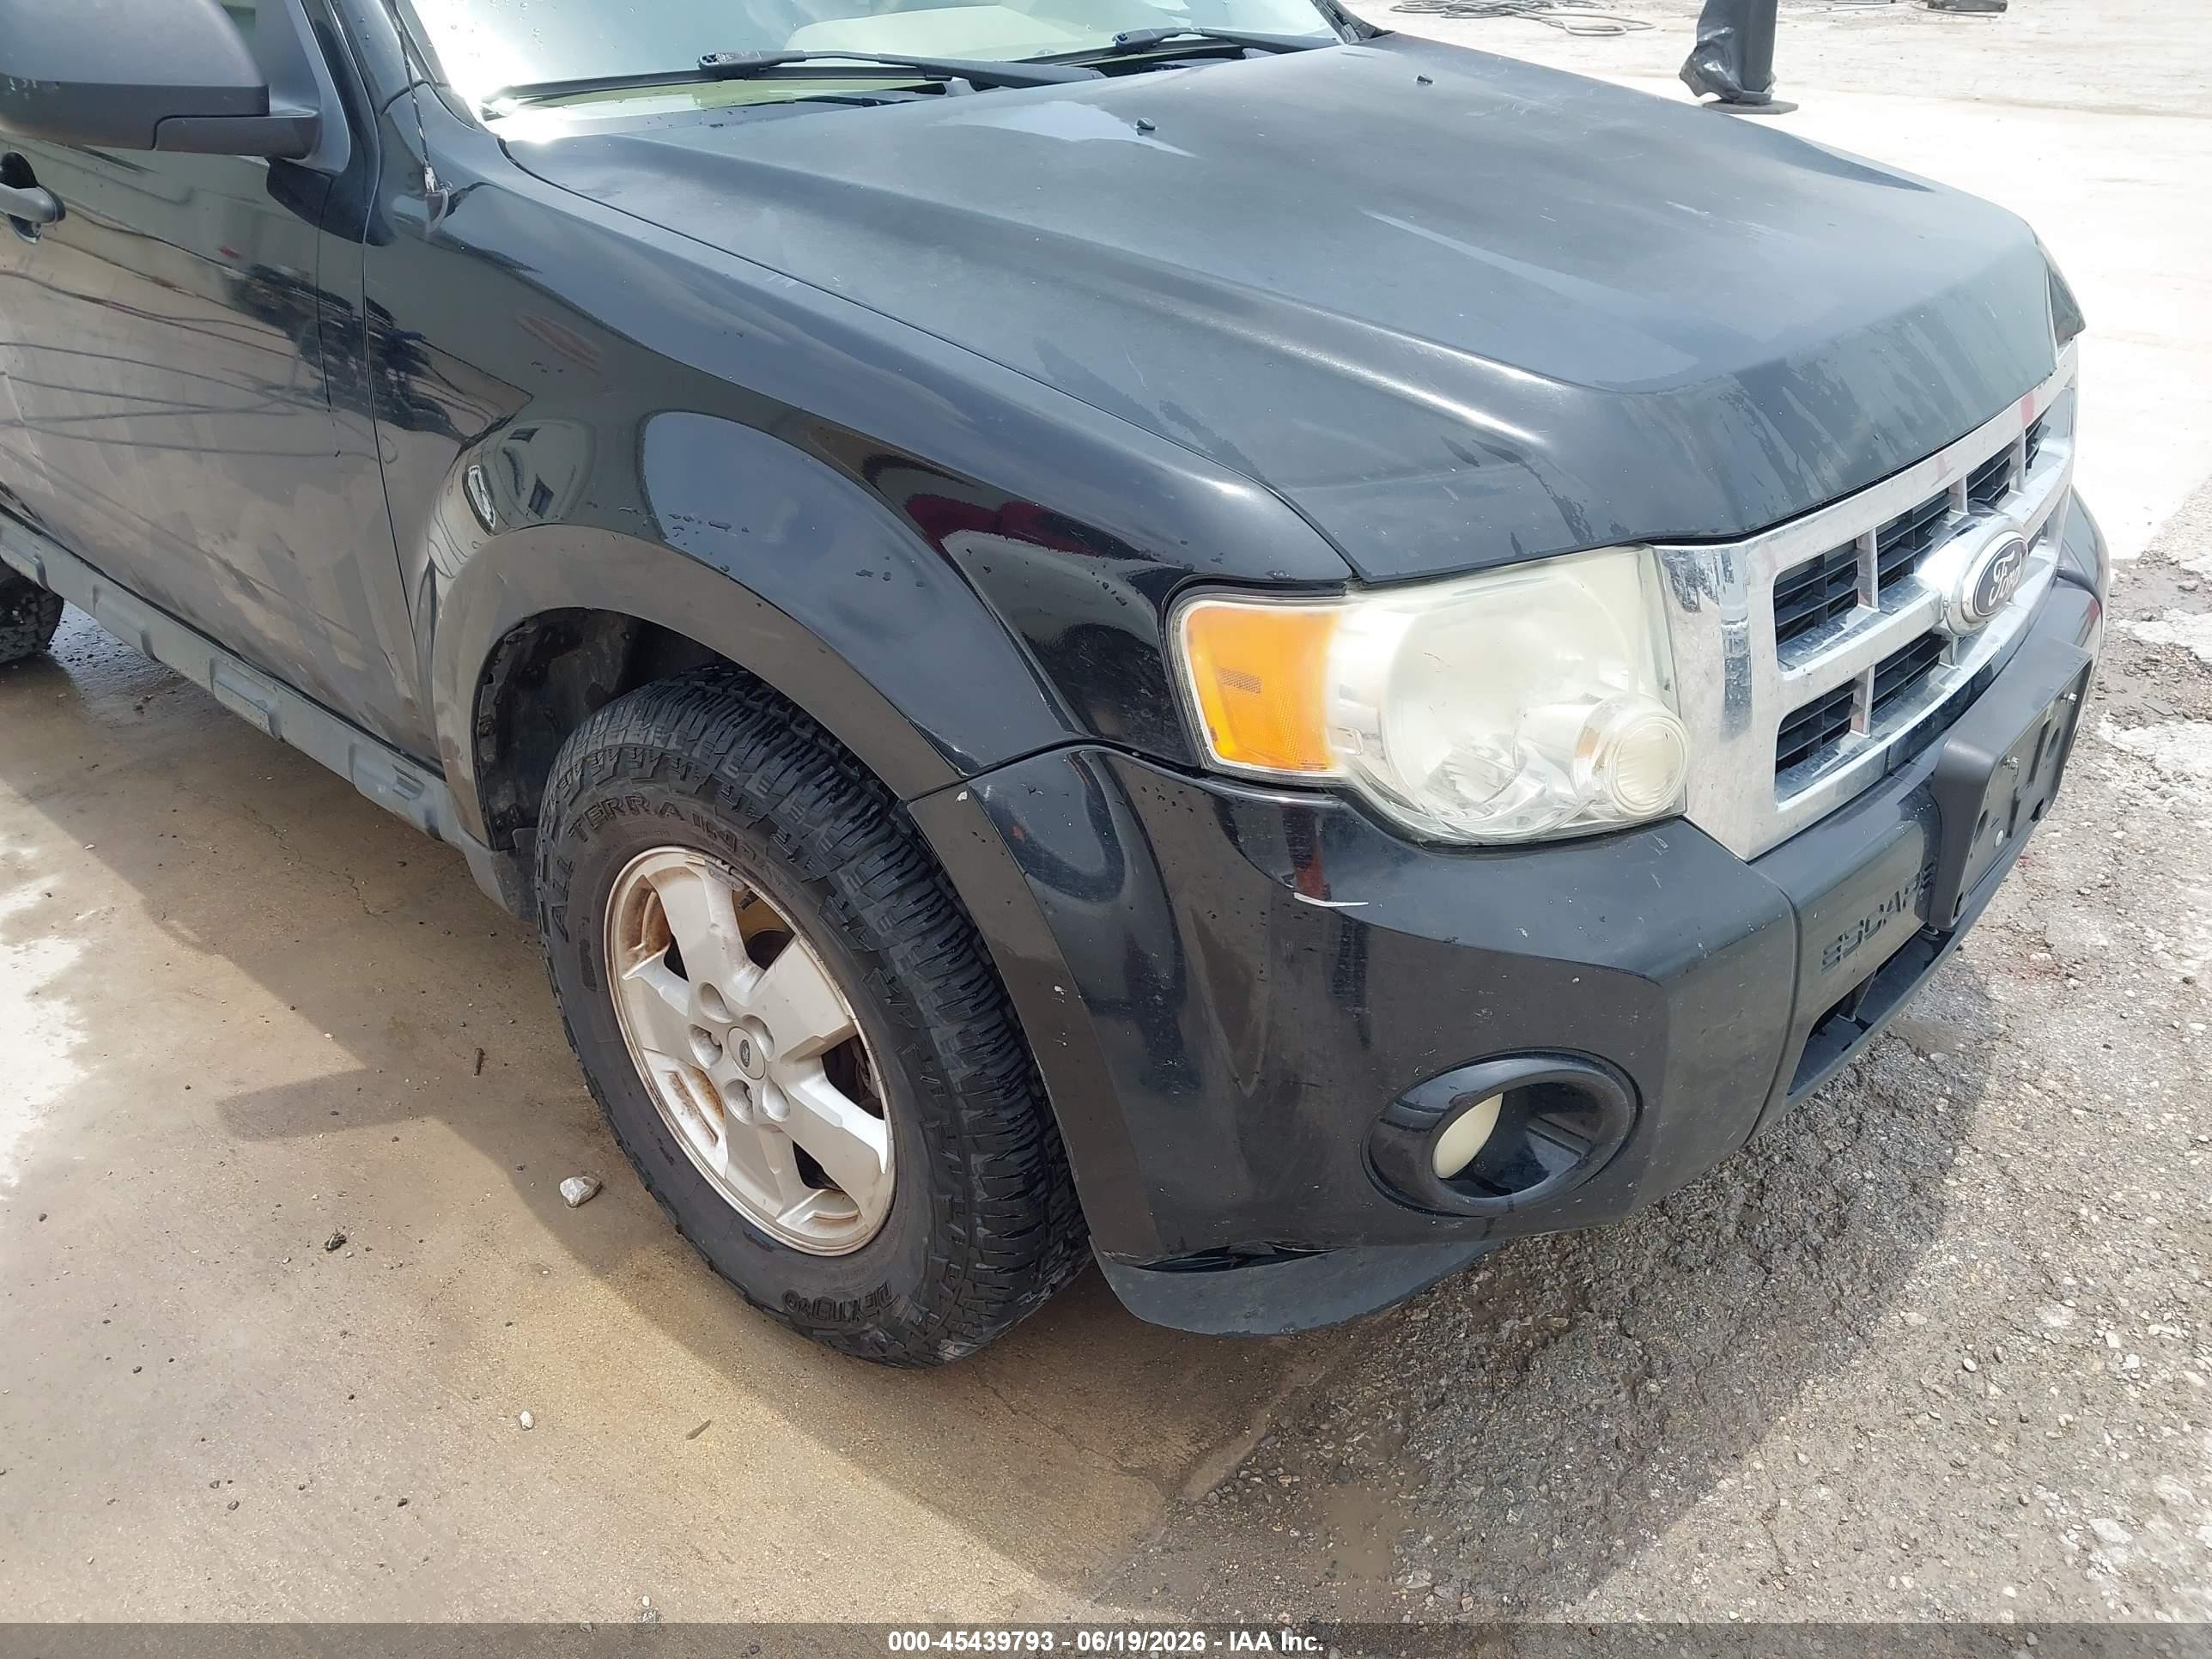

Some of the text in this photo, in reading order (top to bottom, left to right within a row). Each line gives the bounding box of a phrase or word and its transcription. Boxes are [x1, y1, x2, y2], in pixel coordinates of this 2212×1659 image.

[1988, 549, 2023, 606] Ford
[550, 795, 739, 943] ALL TERRAIN
[1820, 862, 1935, 974] ESCAPE
